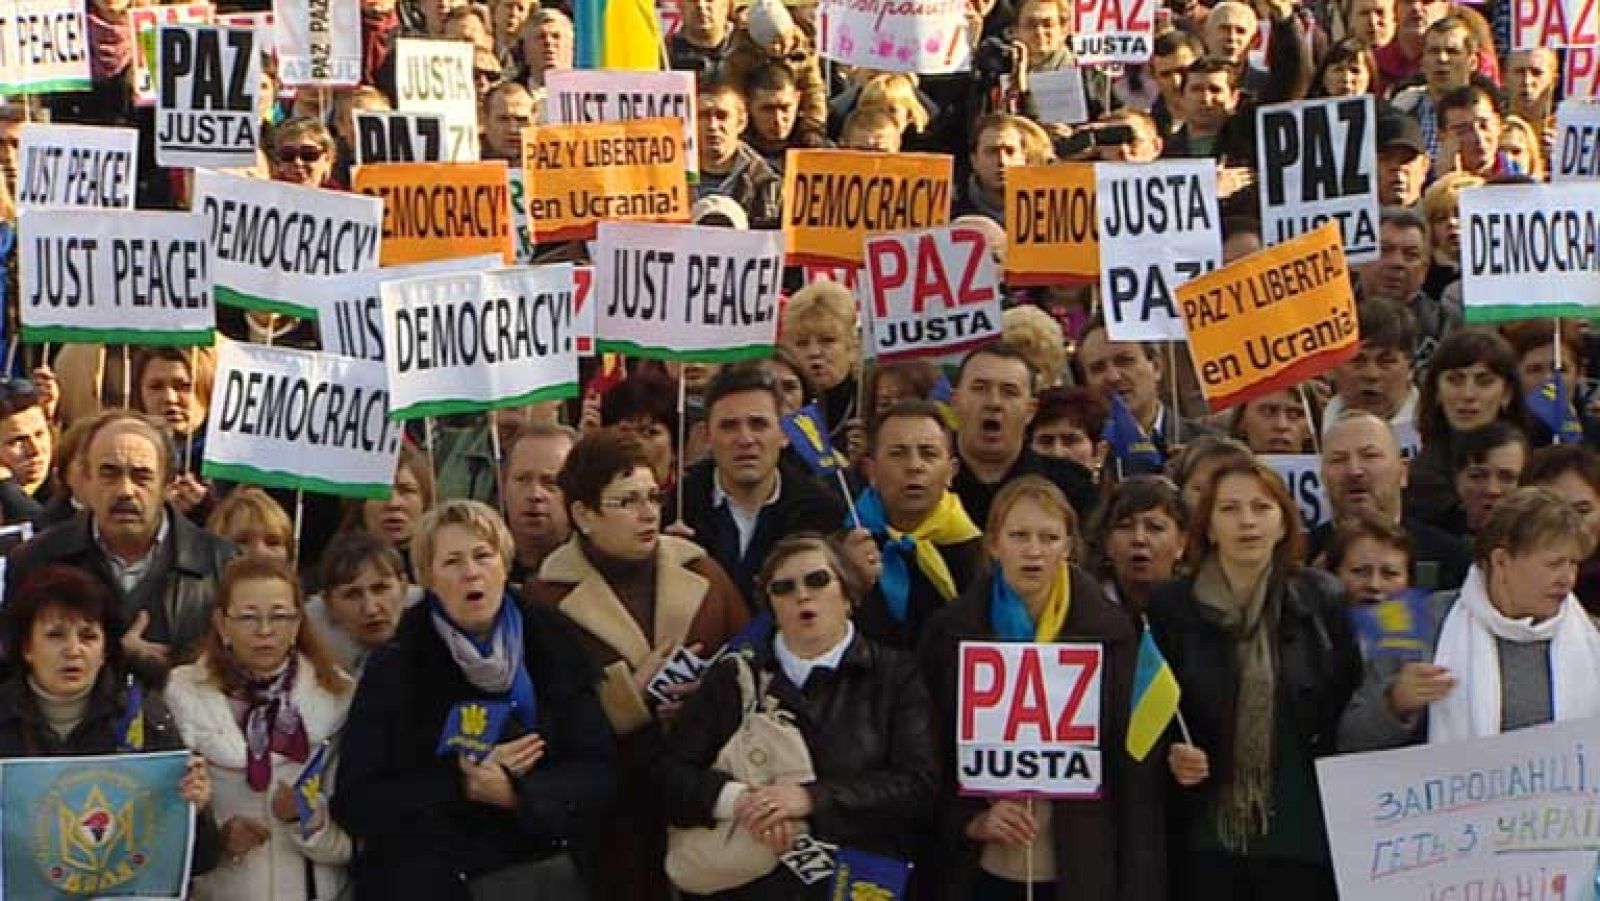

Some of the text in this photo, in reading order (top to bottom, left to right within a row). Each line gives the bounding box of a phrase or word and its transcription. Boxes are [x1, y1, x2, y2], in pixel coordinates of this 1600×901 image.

[17, 13, 85, 64] PEACE!
[1075, 0, 1149, 32] PAZ
[1515, 0, 1597, 46] PAZ
[161, 28, 254, 110] PAZ
[309, 43, 330, 77] PAZ
[1077, 35, 1147, 55] JUSTA
[402, 54, 472, 100] JUSTA
[160, 113, 255, 145] JUSTA
[358, 116, 441, 163] PAZ
[526, 135, 676, 170] PAZ Y LIBERTAD
[1263, 98, 1369, 206] PAZ
[20, 145, 130, 207] JUST PEACE!
[793, 172, 948, 229] DEMOCRACY!
[530, 184, 679, 220] en Ucrania!
[1105, 174, 1211, 237] JUSTA
[204, 197, 377, 276] DEMOCRACY!
[1470, 209, 1600, 276] DEMOCRA
[32, 236, 208, 310] JUST PEACE!
[607, 248, 675, 321] JUST
[685, 254, 780, 326] PEACE!
[867, 227, 994, 319] PAZ
[879, 310, 993, 347] JUSTA
[1183, 288, 1229, 331] PAZ
[1226, 280, 1245, 315] Y
[397, 291, 572, 374] DEMOCRACY!
[1203, 353, 1243, 384] en
[651, 648, 703, 698] PAZ
[961, 646, 1101, 742] PAZ
[962, 750, 1091, 779] JUSTA
[790, 837, 834, 883] PAZ
